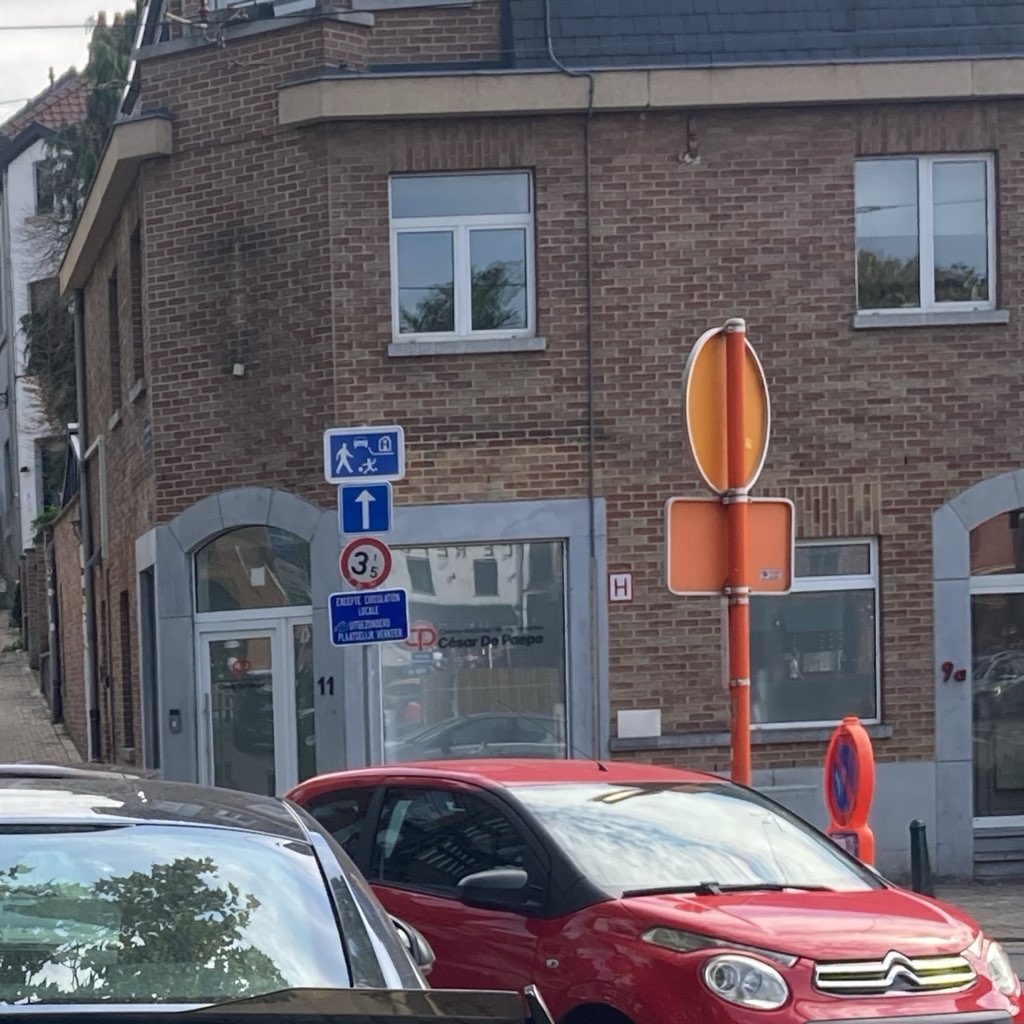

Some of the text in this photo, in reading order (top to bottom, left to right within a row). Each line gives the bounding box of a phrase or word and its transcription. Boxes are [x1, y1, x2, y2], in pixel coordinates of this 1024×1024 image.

[613, 577, 629, 598] H
[358, 606, 379, 616] LOCALE
[376, 628, 403, 638] VERKEER
[438, 634, 543, 648] César De Paepe
[940, 660, 967, 683] 9a
[317, 676, 336, 696] 11
